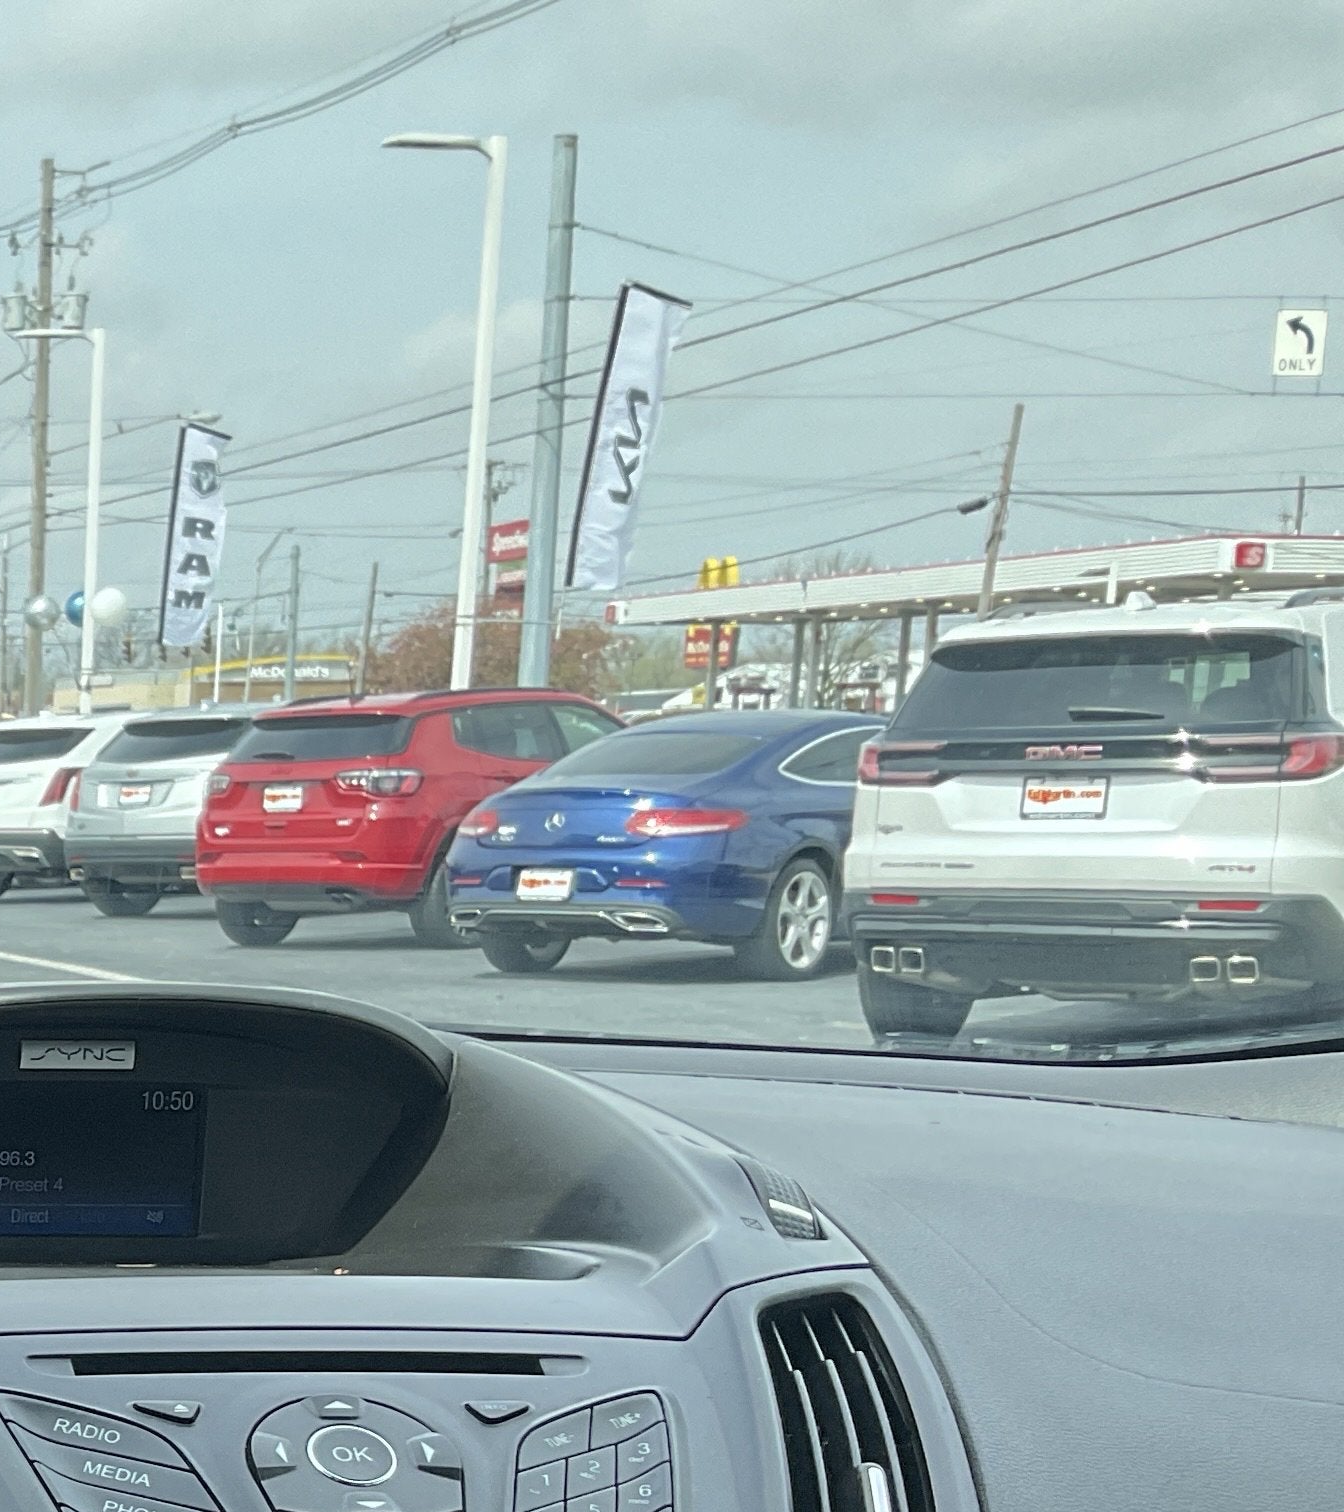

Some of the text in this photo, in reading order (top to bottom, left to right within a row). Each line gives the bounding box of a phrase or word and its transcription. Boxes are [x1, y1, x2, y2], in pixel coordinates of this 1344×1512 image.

[1278, 358, 1317, 371] ONLY
[172, 516, 215, 610] RAM
[1025, 745, 1103, 761] GMC
[30, 1046, 126, 1062] SYNC
[141, 1090, 195, 1111] 10:50
[52, 1177, 64, 1192] 4
[11, 1208, 50, 1223] Direct
[53, 1417, 121, 1444] RADIO
[332, 1446, 374, 1463] OK
[637, 1442, 651, 1455] 3
[82, 1460, 151, 1487] MEDIA
[588, 1459, 601, 1473] 2
[541, 1474, 550, 1486] 1
[638, 1484, 652, 1497] 6
